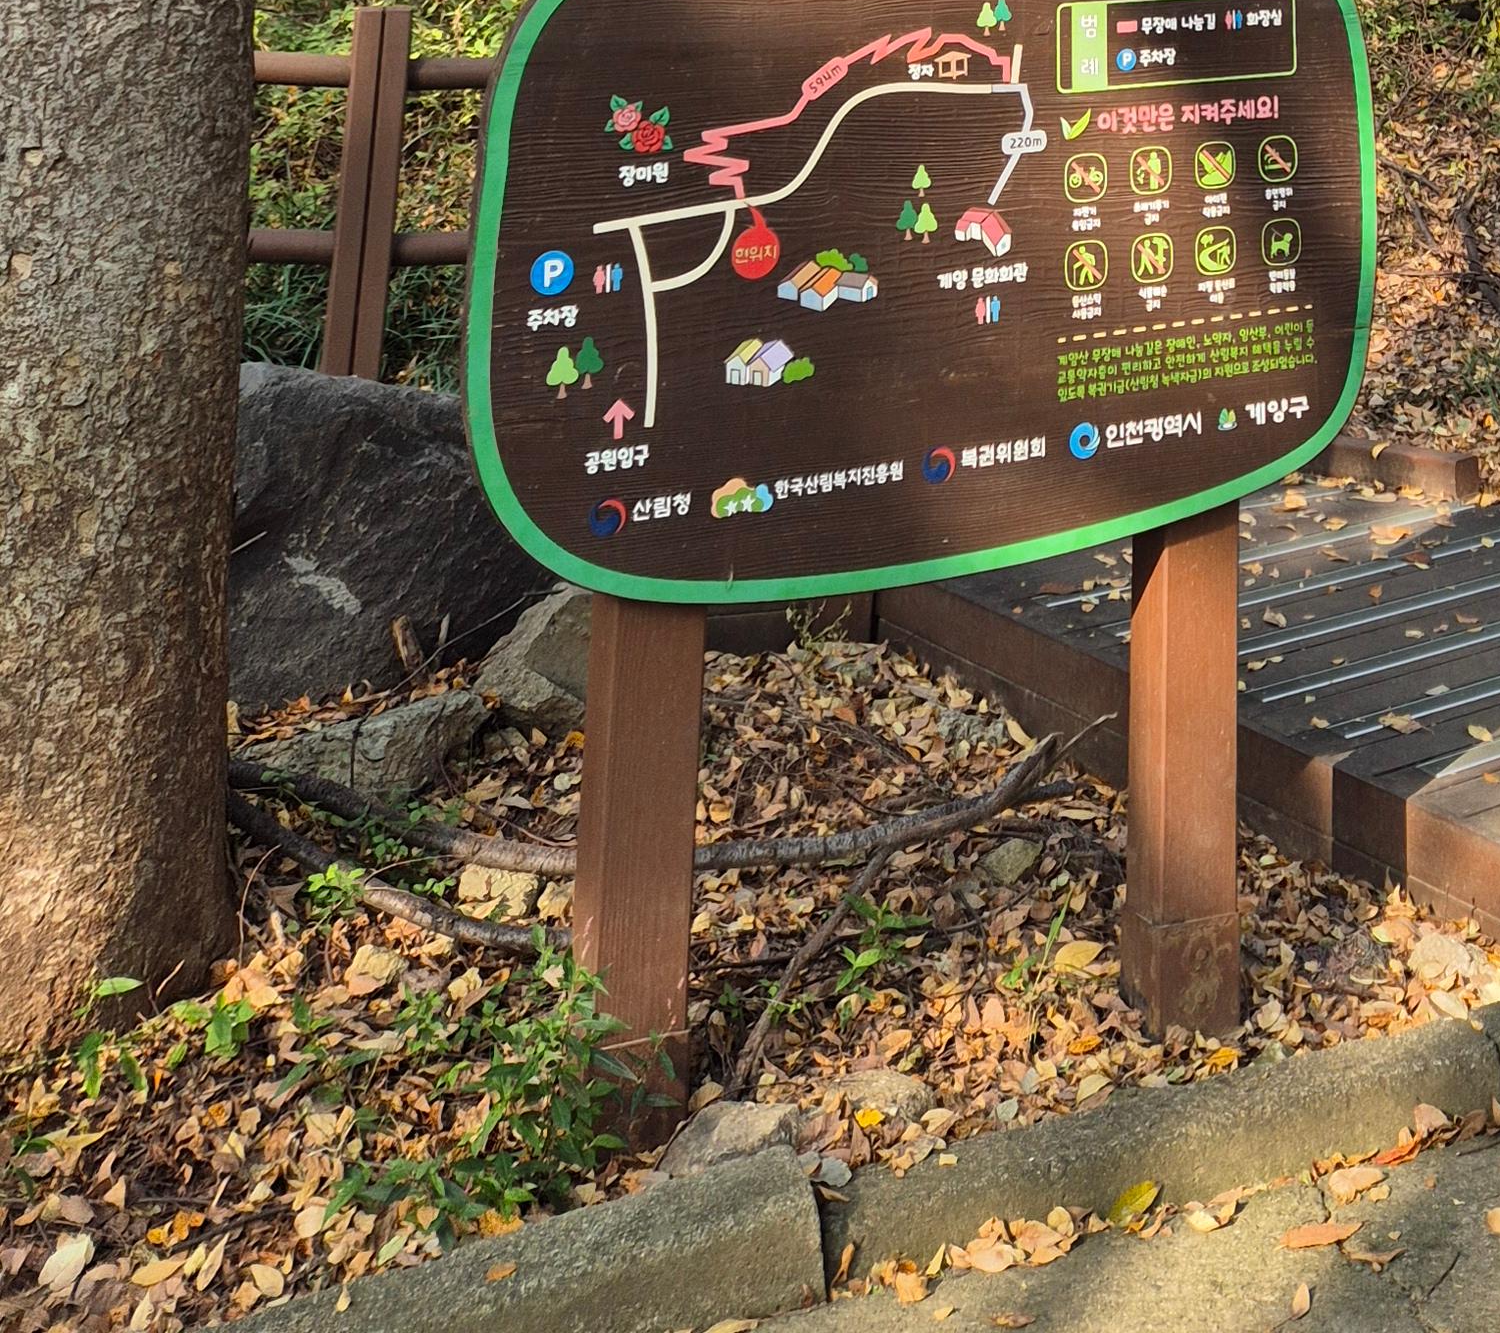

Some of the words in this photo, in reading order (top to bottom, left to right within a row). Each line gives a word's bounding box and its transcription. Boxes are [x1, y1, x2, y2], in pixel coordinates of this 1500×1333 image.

[1141, 16, 1178, 34] 무장애
[1181, 13, 1216, 31] 나눔길
[1246, 9, 1283, 28] 화장실
[908, 64, 934, 80] 정자
[1139, 48, 1177, 68] 주차장
[808, 64, 842, 94] 594m
[1097, 103, 1175, 134] 이것만은
[1180, 95, 1279, 125] 지켜주세요!
[1009, 136, 1042, 150] 220m
[618, 161, 670, 187] 장미원
[937, 269, 969, 291] 계양
[971, 262, 1028, 284] 문화회관
[526, 304, 579, 331] 주차장
[1057, 350, 1089, 367] 계양산
[1092, 346, 1121, 363] 무장애
[1125, 339, 1163, 357] 나눔길은
[1203, 331, 1236, 346] 노약자,
[1239, 326, 1271, 342] 임산부,
[1274, 321, 1303, 336] 어린이
[1057, 365, 1118, 384] 교통약자들이
[1121, 357, 1162, 375] 편리하고
[1165, 352, 1206, 369] 안전하게
[1210, 346, 1248, 363] 산림복지
[1284, 337, 1302, 352] 누릴
[1306, 335, 1315, 349] 수
[1057, 384, 1085, 403] 있도록
[1214, 361, 1250, 378] 지원으로
[1251, 354, 1318, 373] 조성되었습니다.
[1245, 395, 1310, 426] 계양구
[1104, 410, 1203, 449] 인천광역시
[583, 444, 650, 474] 공원입구
[961, 435, 1046, 470] 복권위원회
[774, 460, 904, 500] 한국산림복지진흥원
[632, 492, 692, 522] 산림청
